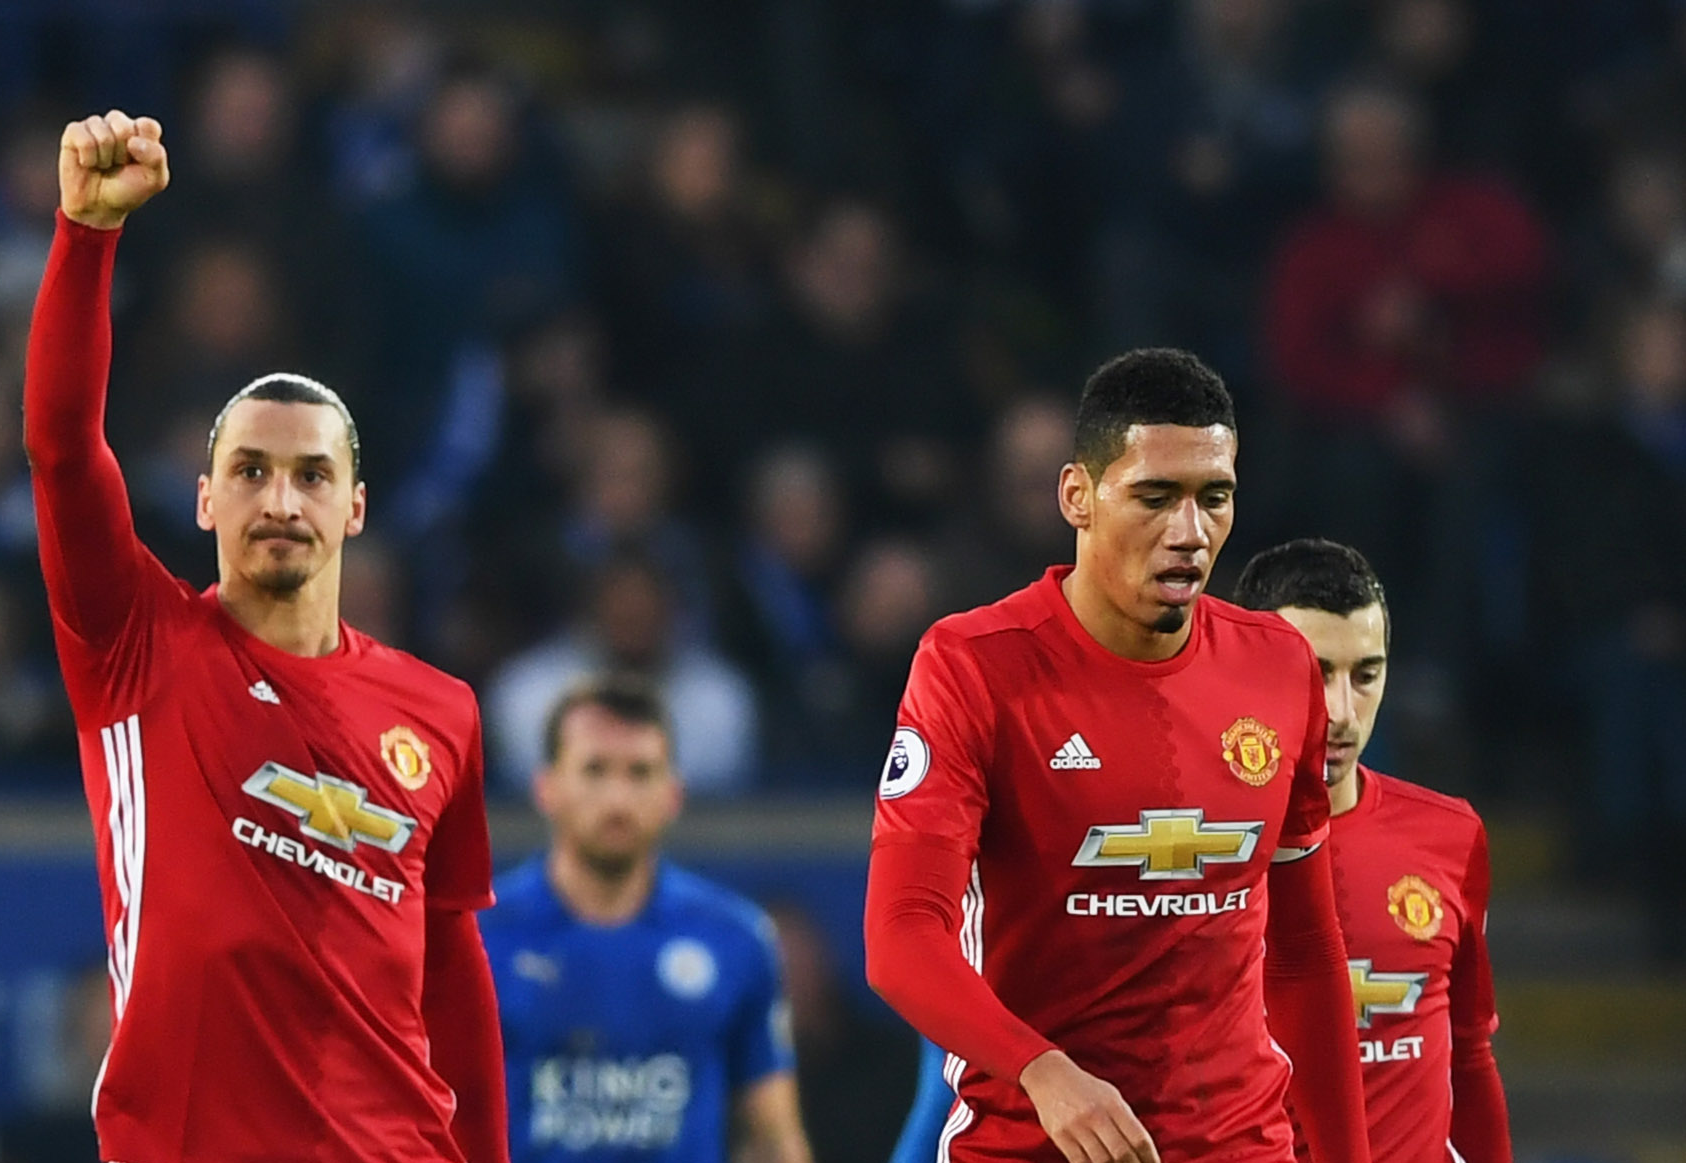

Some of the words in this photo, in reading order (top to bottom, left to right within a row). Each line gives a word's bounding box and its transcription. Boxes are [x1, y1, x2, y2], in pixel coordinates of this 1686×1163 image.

[1050, 757, 1101, 769] adidas
[232, 817, 405, 904] CHEVROLET
[1066, 886, 1251, 916] CHEVROLET
[531, 1054, 692, 1112] KING
